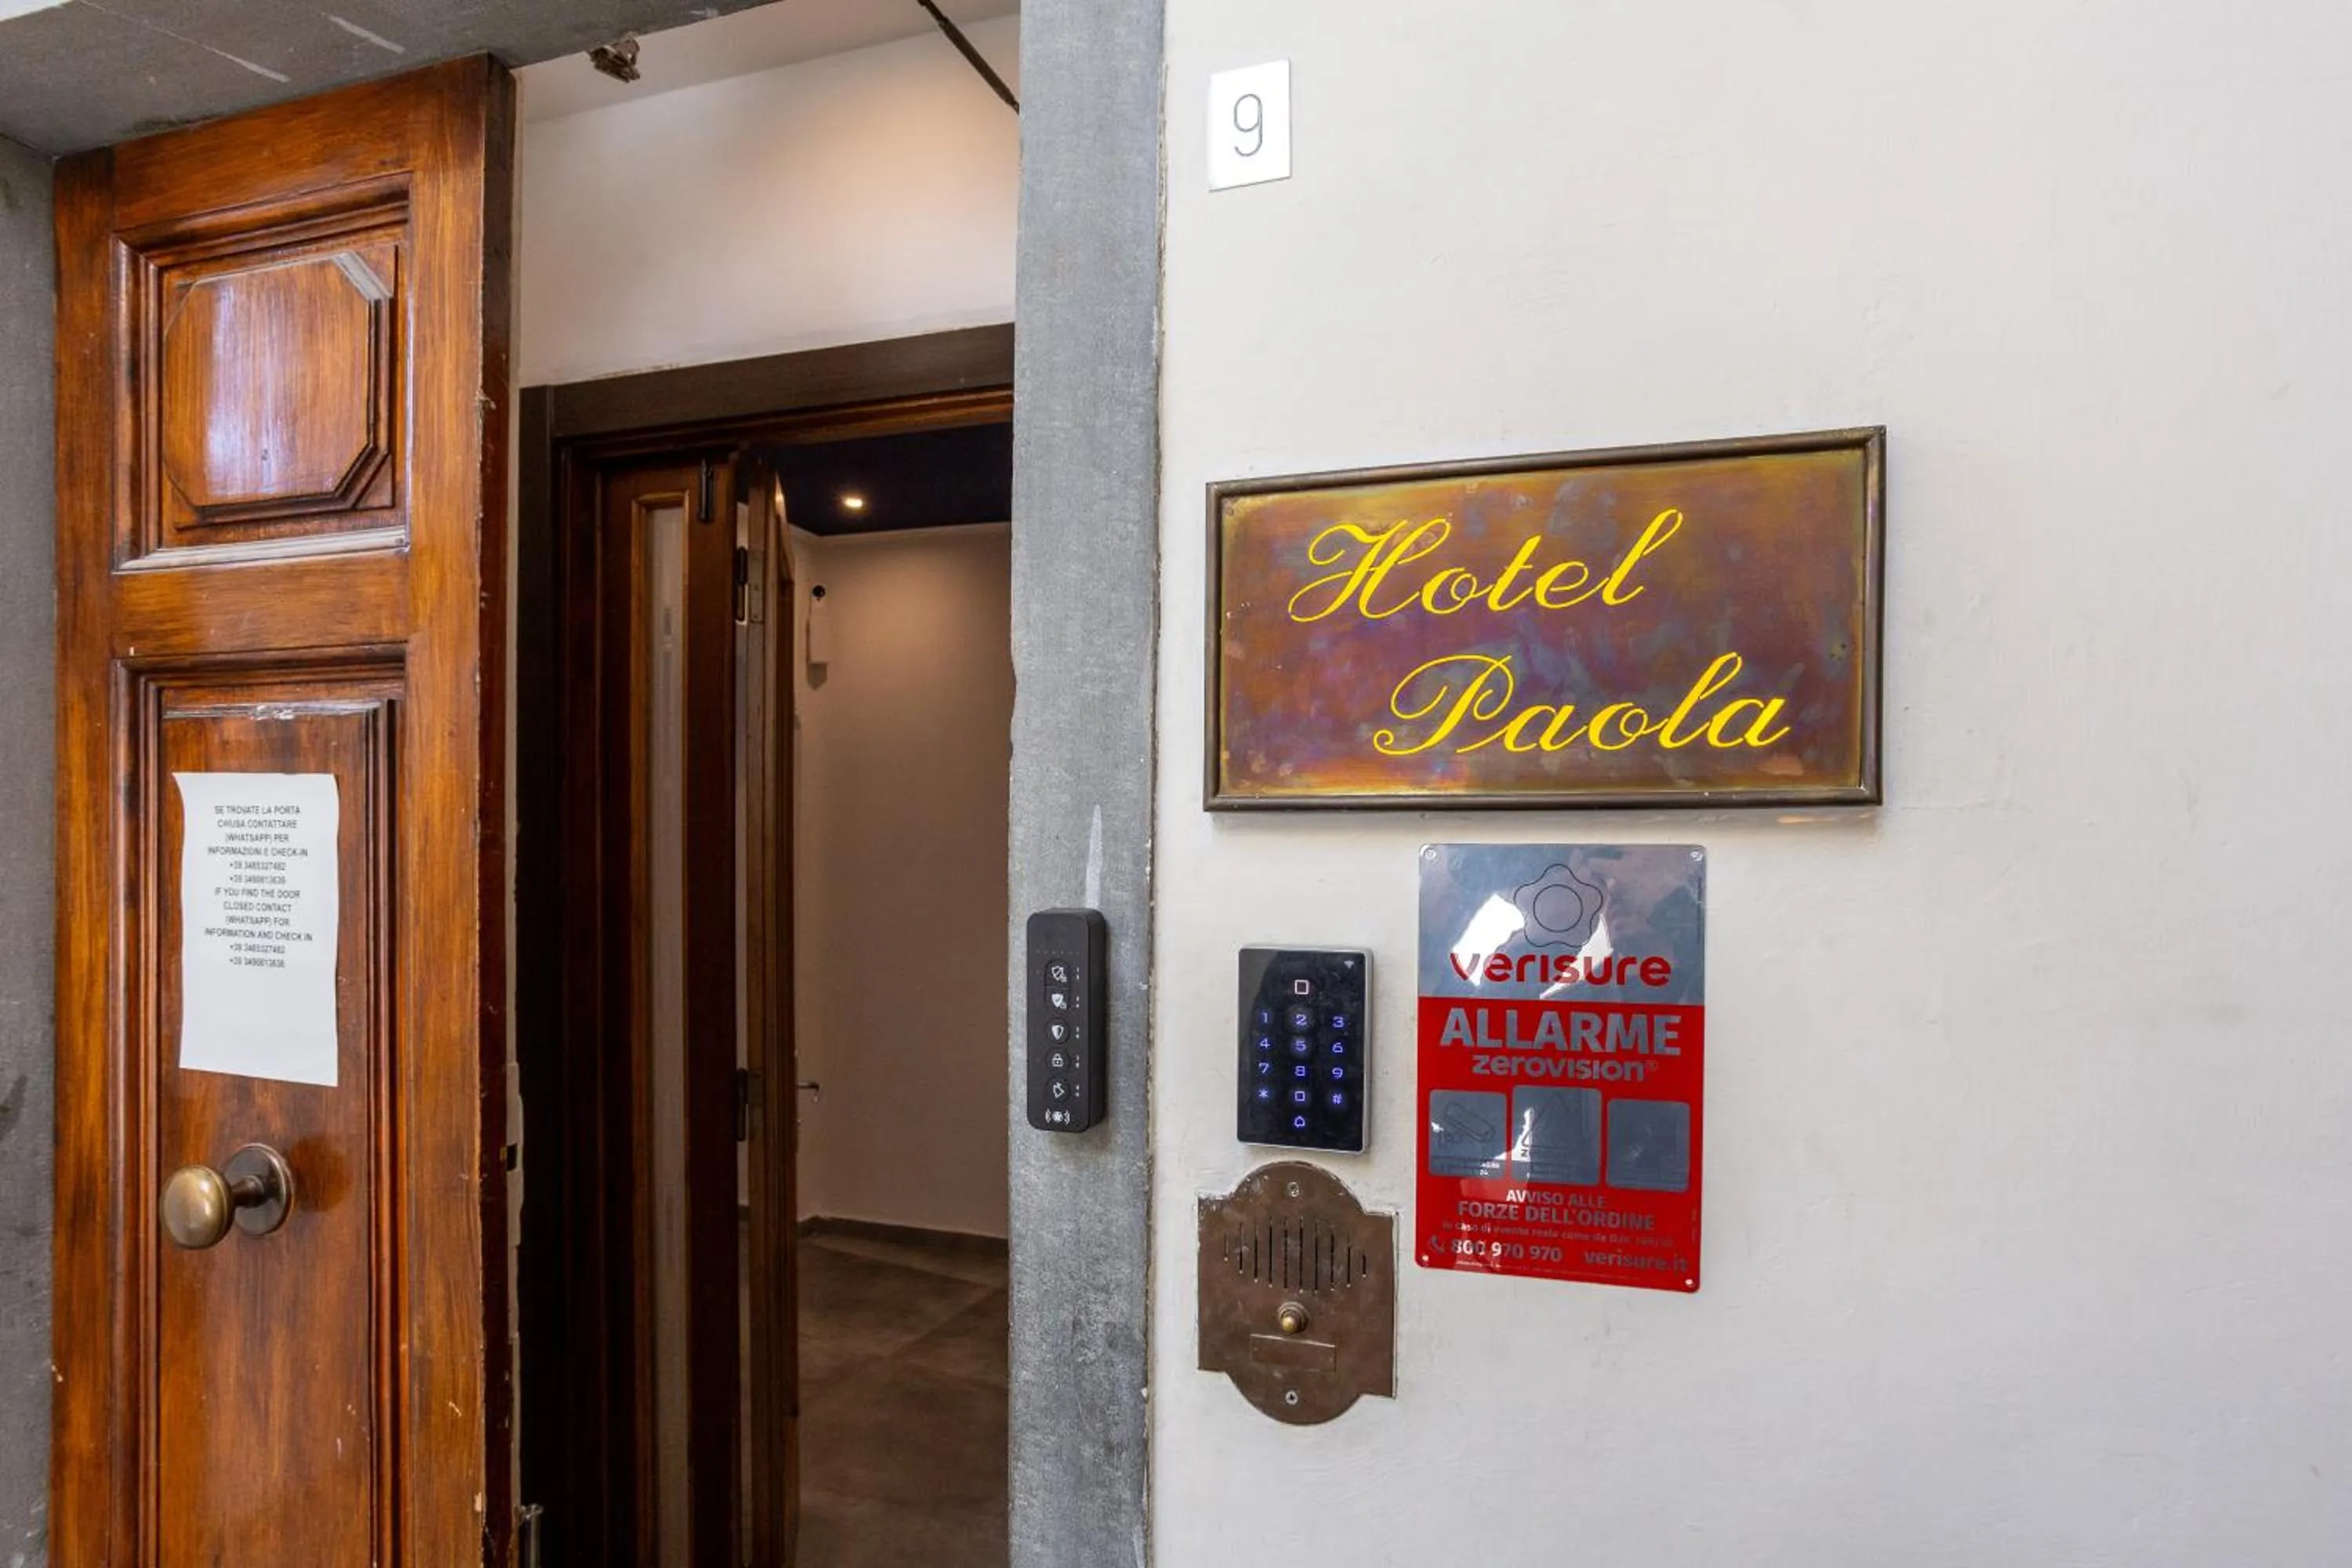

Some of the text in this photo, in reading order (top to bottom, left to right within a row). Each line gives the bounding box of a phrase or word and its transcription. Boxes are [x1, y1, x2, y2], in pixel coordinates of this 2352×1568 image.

[1233, 93, 1263, 157] 9
[1287, 508, 1684, 623] Hotel
[1373, 651, 1791, 756] Paola
[213, 804, 301, 815] SE TROVATE LA PORTA
[247, 818, 297, 829] CONTATTARE
[274, 833, 289, 843] PER
[207, 846, 262, 856] INFORMAZIONI
[214, 887, 301, 899] IF YOU FIND THE DOOR
[223, 901, 292, 913] CLOSED CONTACT
[274, 916, 290, 927] FOR
[204, 927, 256, 938] INFORMATION
[256, 931, 274, 940] AND
[1450, 952, 1672, 987] verisure
[1261, 1012, 1345, 1028] 1 2 3
[1439, 1007, 1682, 1056] ALLARME
[1259, 1038, 1343, 1053] 4 5 6
[1258, 1062, 1344, 1079] 7 8 9
[1505, 1189, 1606, 1209] AVVISO ALLE
[1457, 1200, 1656, 1231] FORZE DELL'ORDINE
[1451, 1238, 1486, 1256] 800
[1491, 1241, 1524, 1258] 970
[1530, 1246, 1562, 1262] 970
[1583, 1248, 1689, 1274] verisure.it
